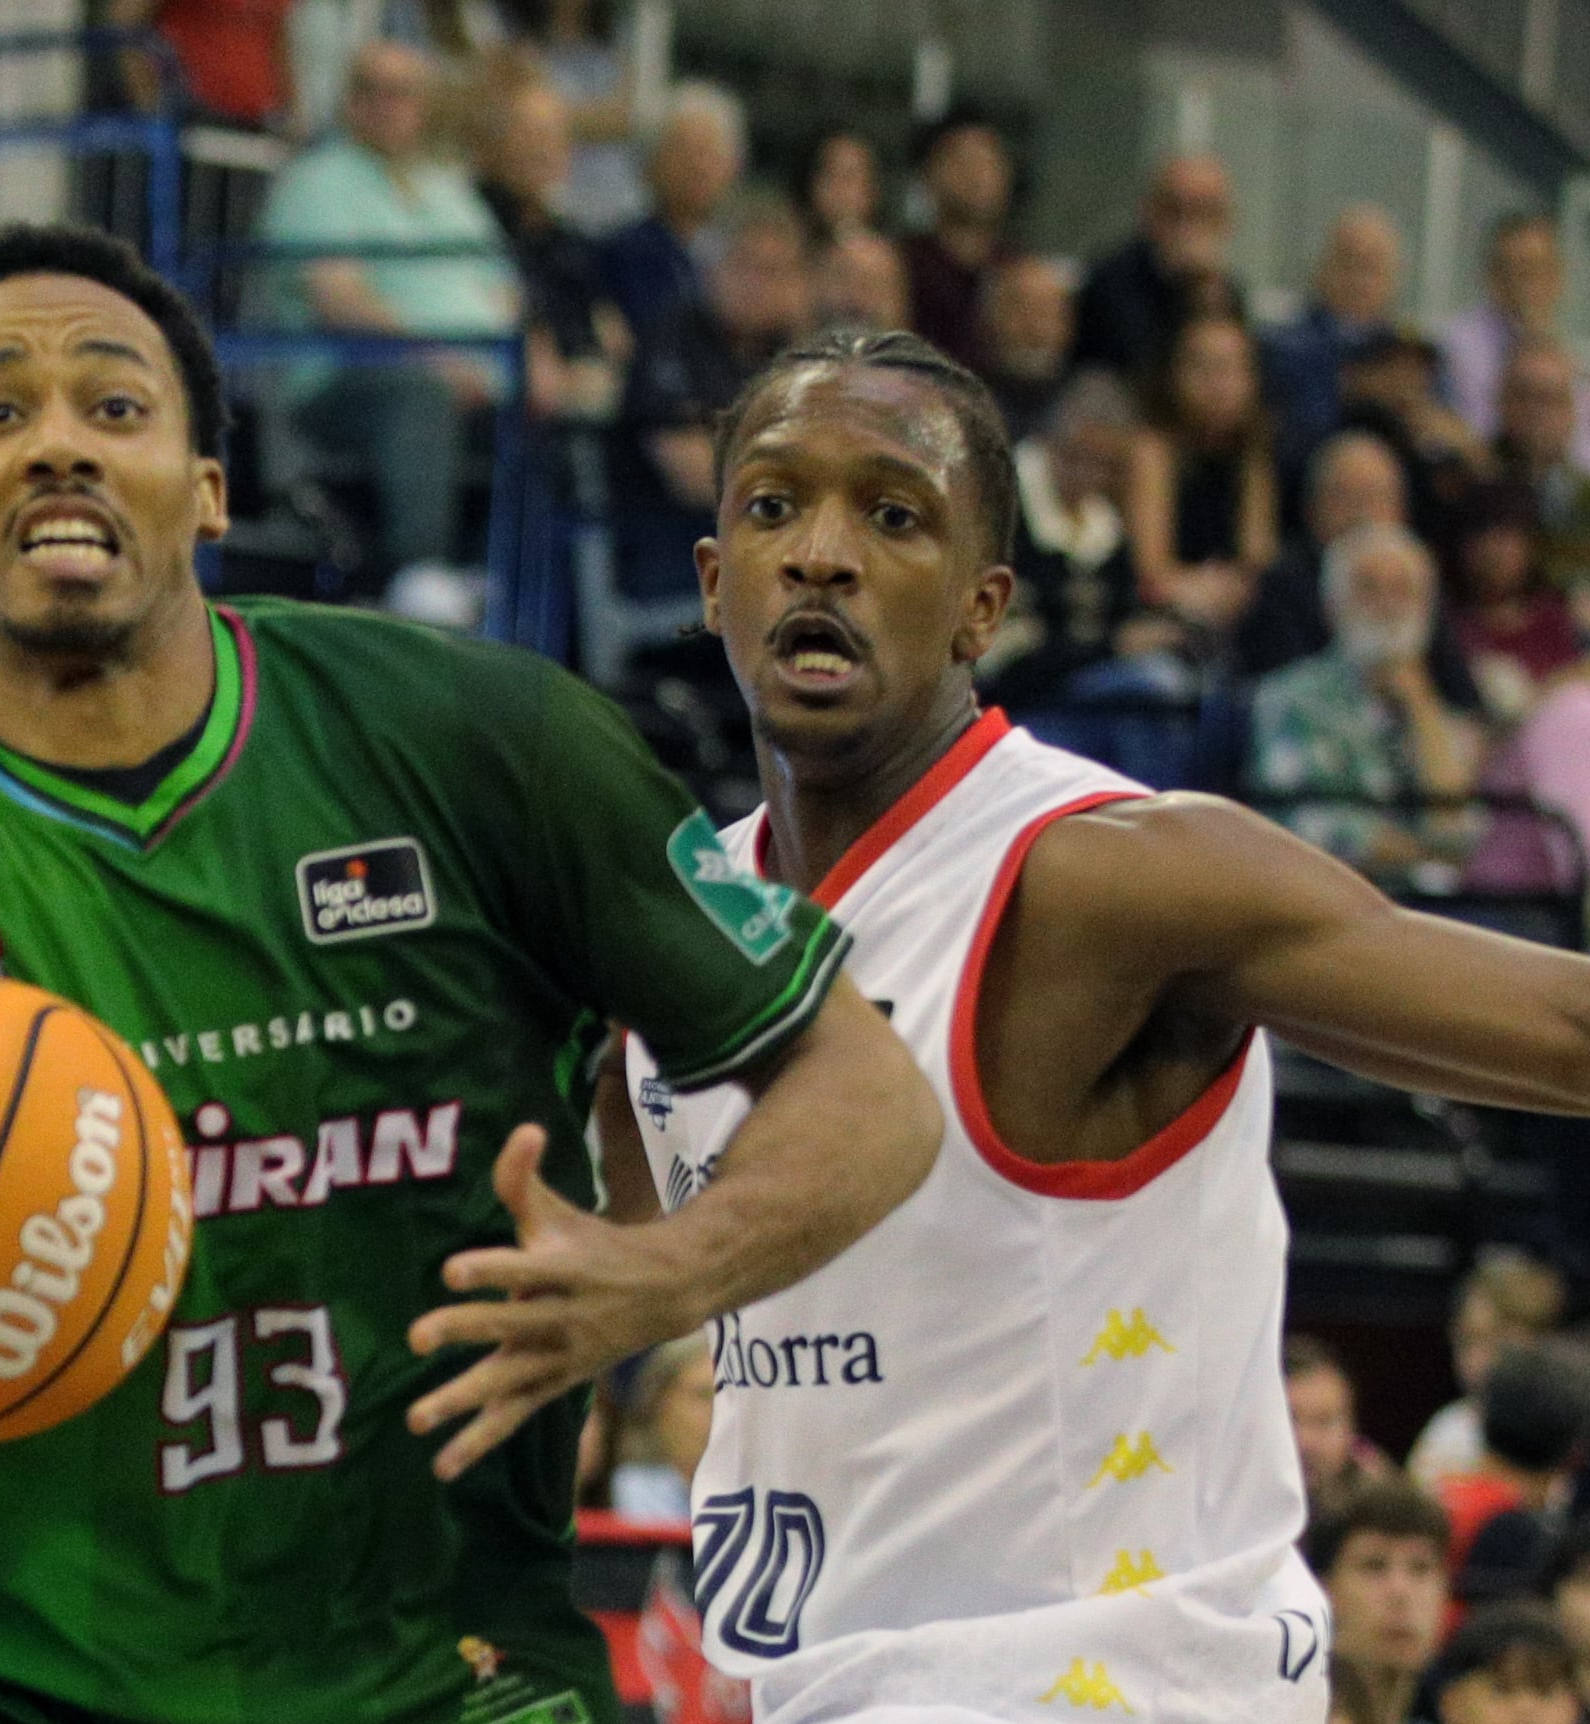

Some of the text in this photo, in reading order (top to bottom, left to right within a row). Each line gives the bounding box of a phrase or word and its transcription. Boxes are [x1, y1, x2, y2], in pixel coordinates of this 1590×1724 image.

[313, 879, 365, 909] liga
[317, 892, 425, 930] endesa
[142, 998, 417, 1070] IVERSARIO
[189, 1098, 463, 1220] iRAN
[724, 1312, 885, 1388] dorra
[159, 1303, 347, 1492] 93
[693, 1485, 826, 1661] 70
